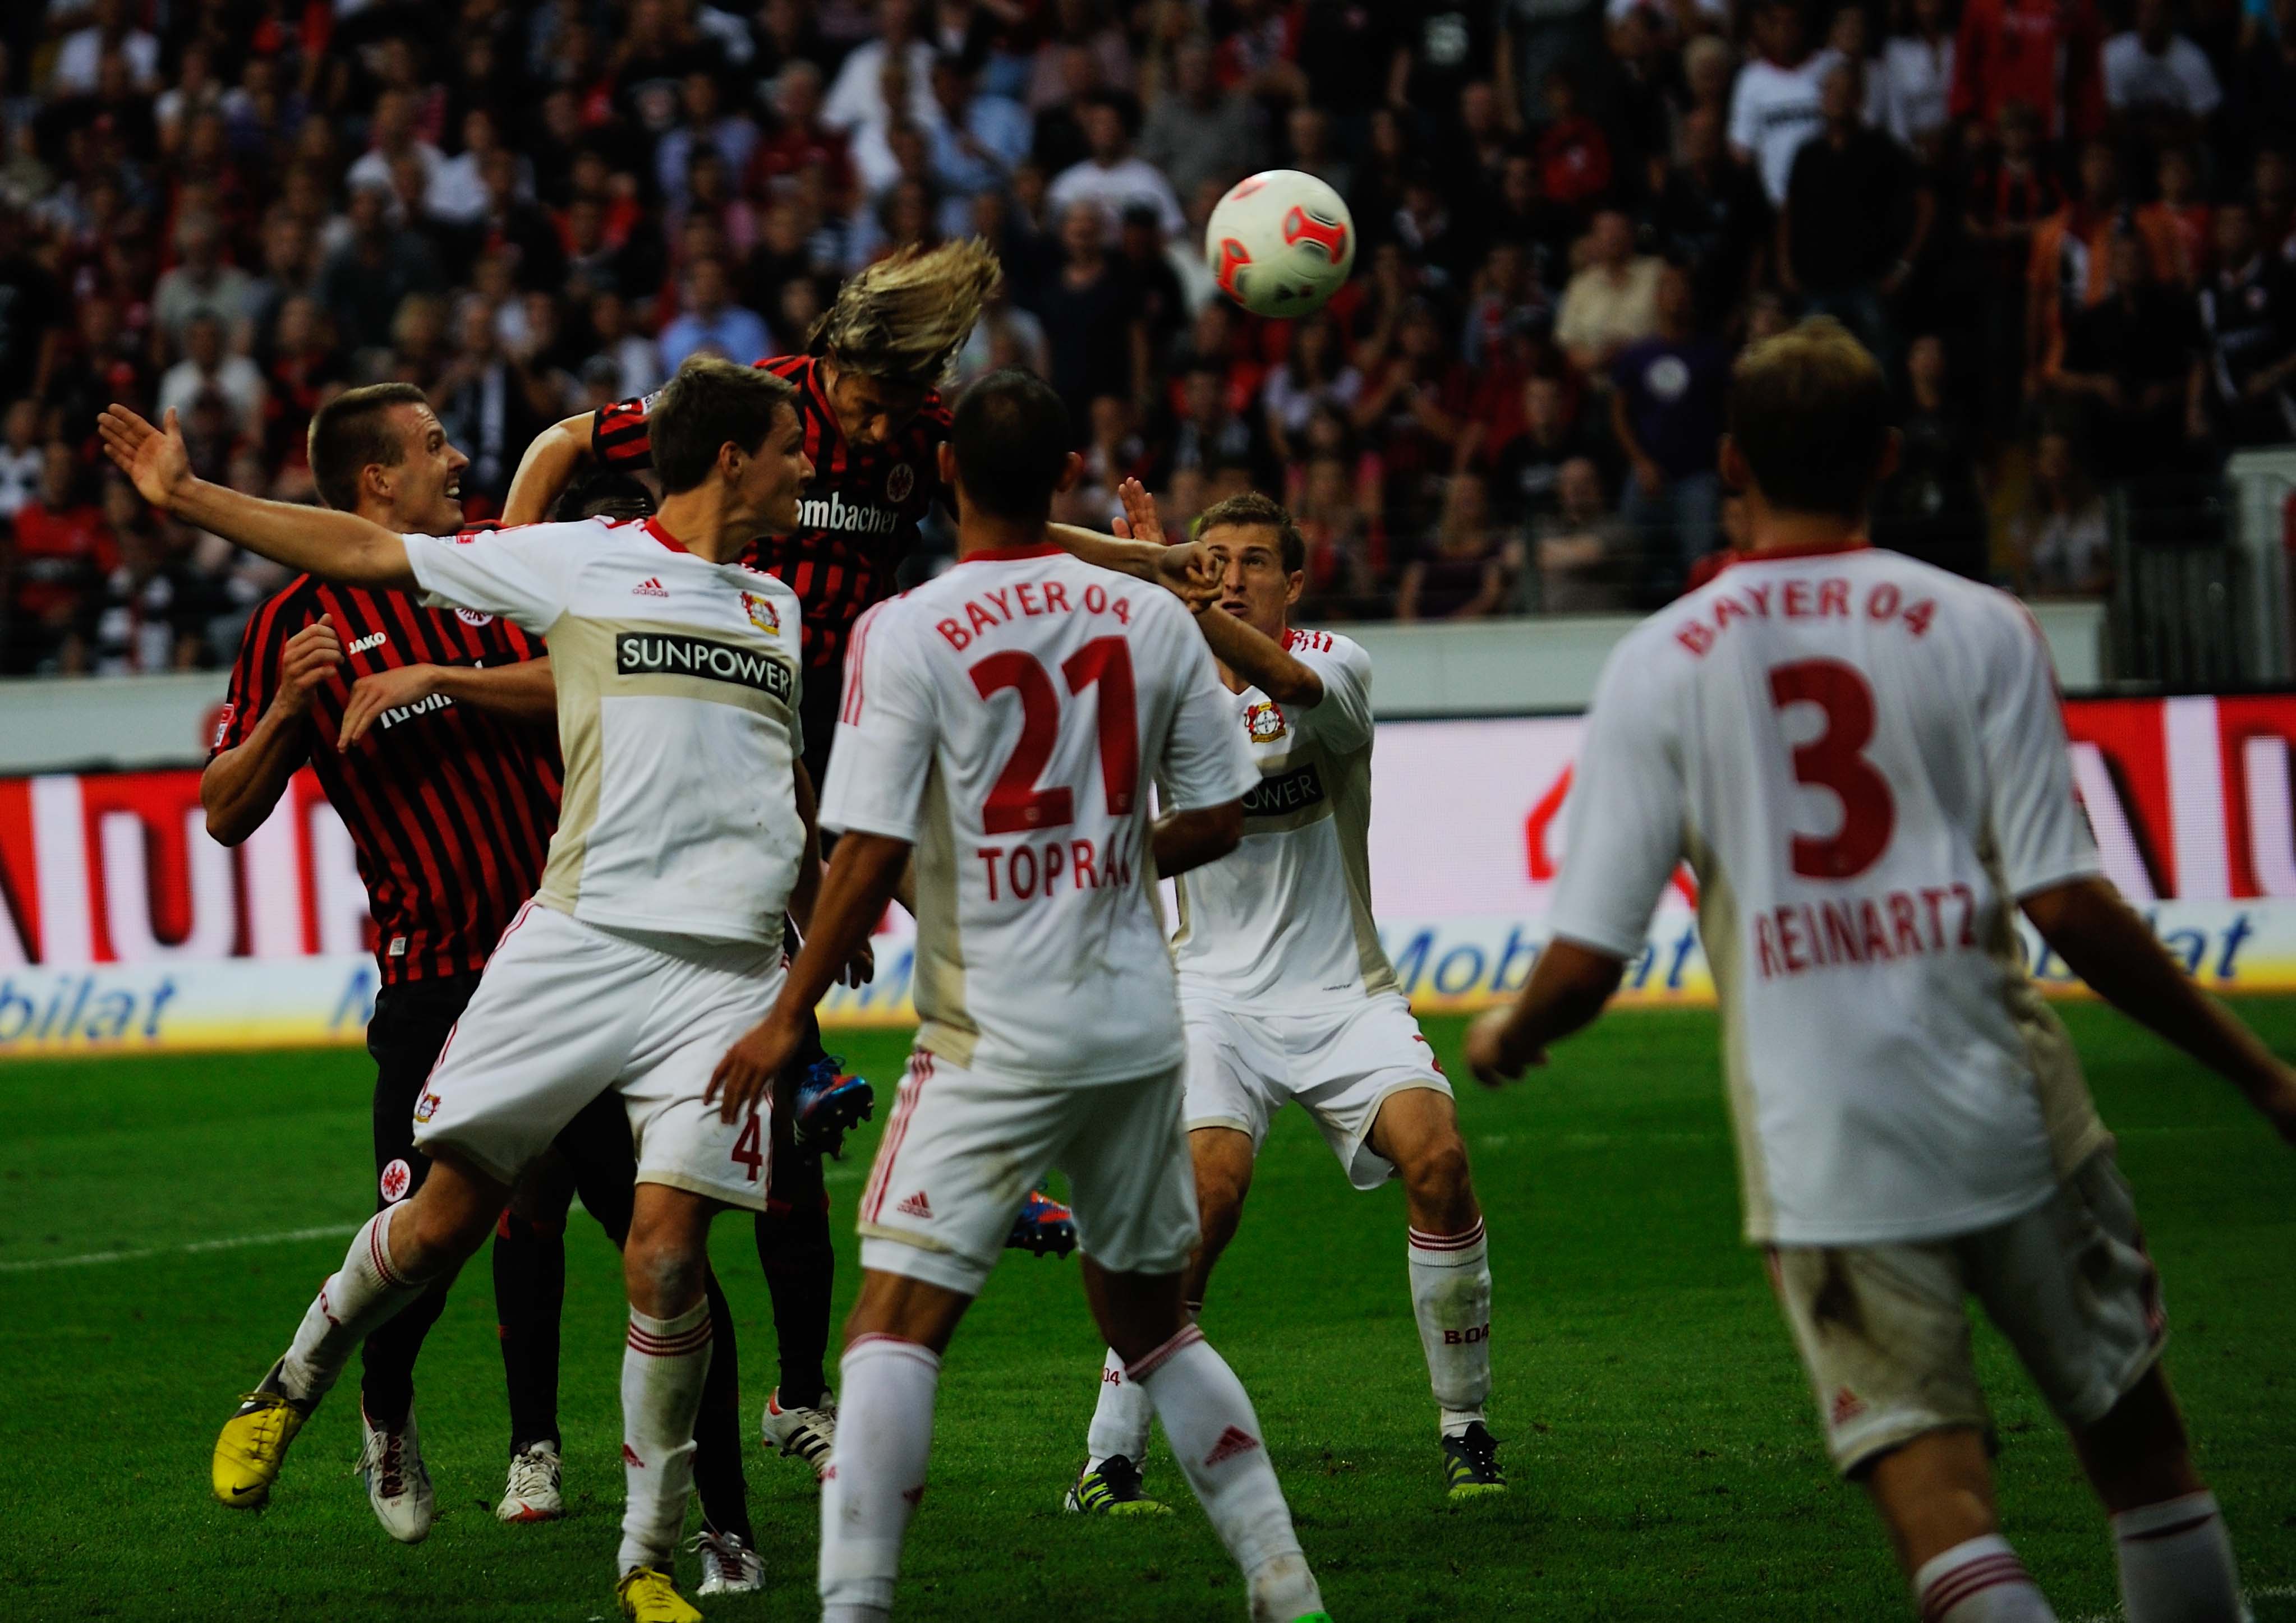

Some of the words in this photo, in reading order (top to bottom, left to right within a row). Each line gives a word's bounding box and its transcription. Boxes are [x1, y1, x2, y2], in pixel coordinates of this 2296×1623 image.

[348, 631, 386, 655] JAKO
[936, 581, 1072, 652] BAYER
[1085, 584, 1132, 625] 04
[1674, 578, 1852, 657] BAYER
[1866, 581, 1938, 636] 04
[622, 638, 791, 694] SUNPOWER
[969, 635, 1138, 835] 21
[1769, 655, 1895, 879] 3
[1756, 882, 1977, 980] REINARTZ
[731, 1114, 762, 1182] 4
